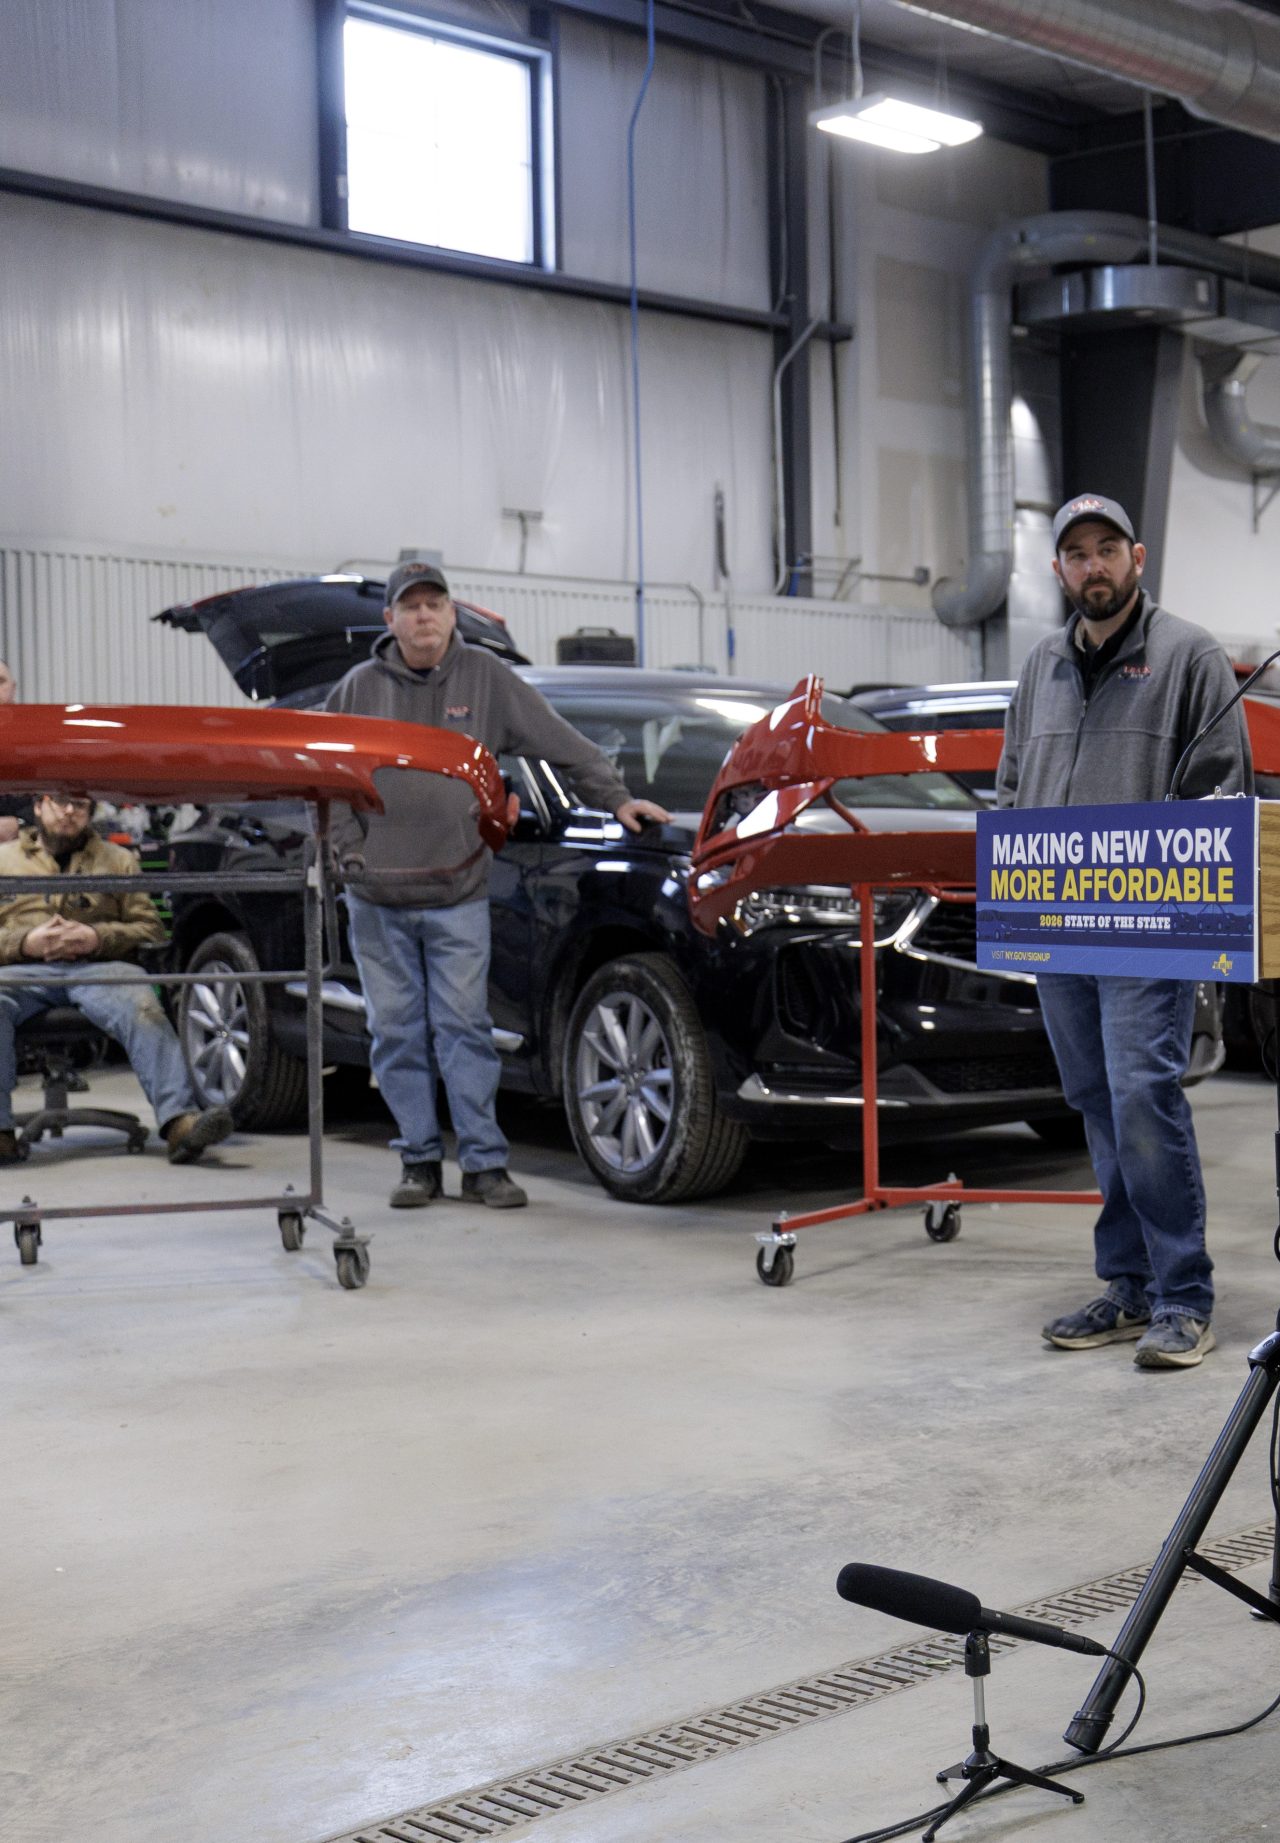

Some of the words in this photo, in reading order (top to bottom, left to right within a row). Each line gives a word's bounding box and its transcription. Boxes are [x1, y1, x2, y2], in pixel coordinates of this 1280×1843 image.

[992, 831, 1084, 865] MAKING
[1091, 829, 1149, 864] NEW
[1155, 827, 1232, 863] YORK
[990, 869, 1055, 901] MORE
[1061, 867, 1234, 903] AFFORDABLE
[1039, 914, 1063, 928] 2026
[1064, 915, 1096, 928] STATE
[1097, 915, 1111, 929] OF
[1113, 916, 1135, 930] THE
[1136, 916, 1171, 930] STATE
[991, 950, 1004, 960] VISIT
[1005, 951, 1051, 962] NY.GOV/SIGNUP
